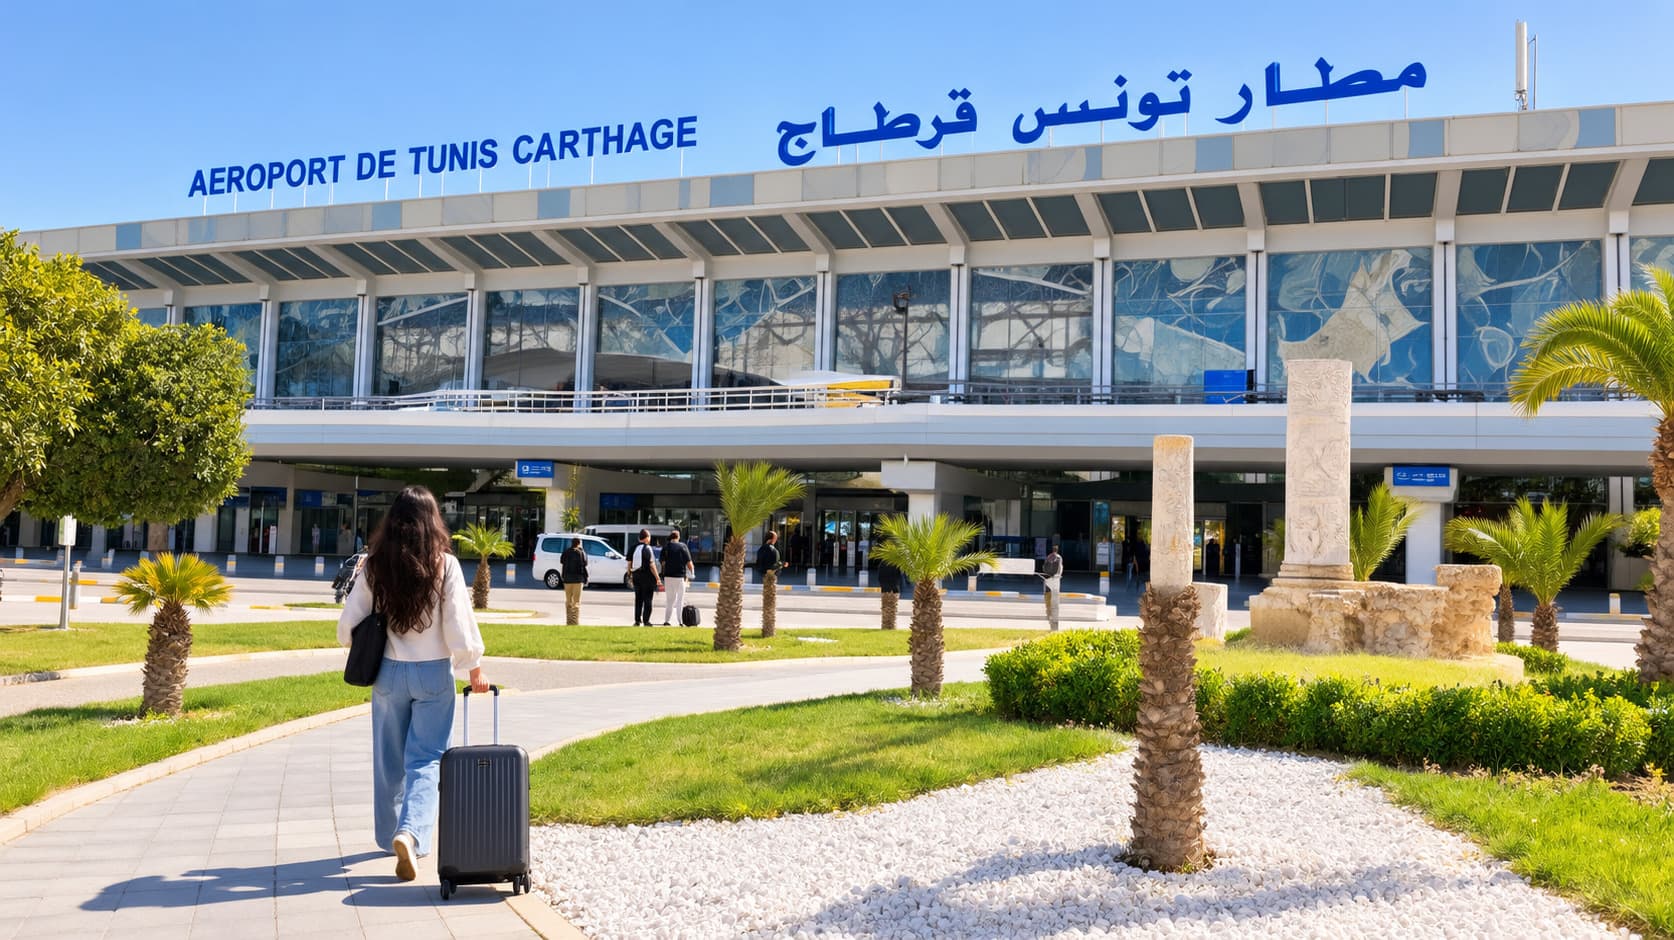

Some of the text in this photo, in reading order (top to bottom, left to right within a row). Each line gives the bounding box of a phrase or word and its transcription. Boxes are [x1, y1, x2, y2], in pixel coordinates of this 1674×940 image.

[188, 115, 698, 198] AEROPORT DE TUNIS CARTHAGE
[776, 57, 1427, 167] مطار تونس قرطاج
